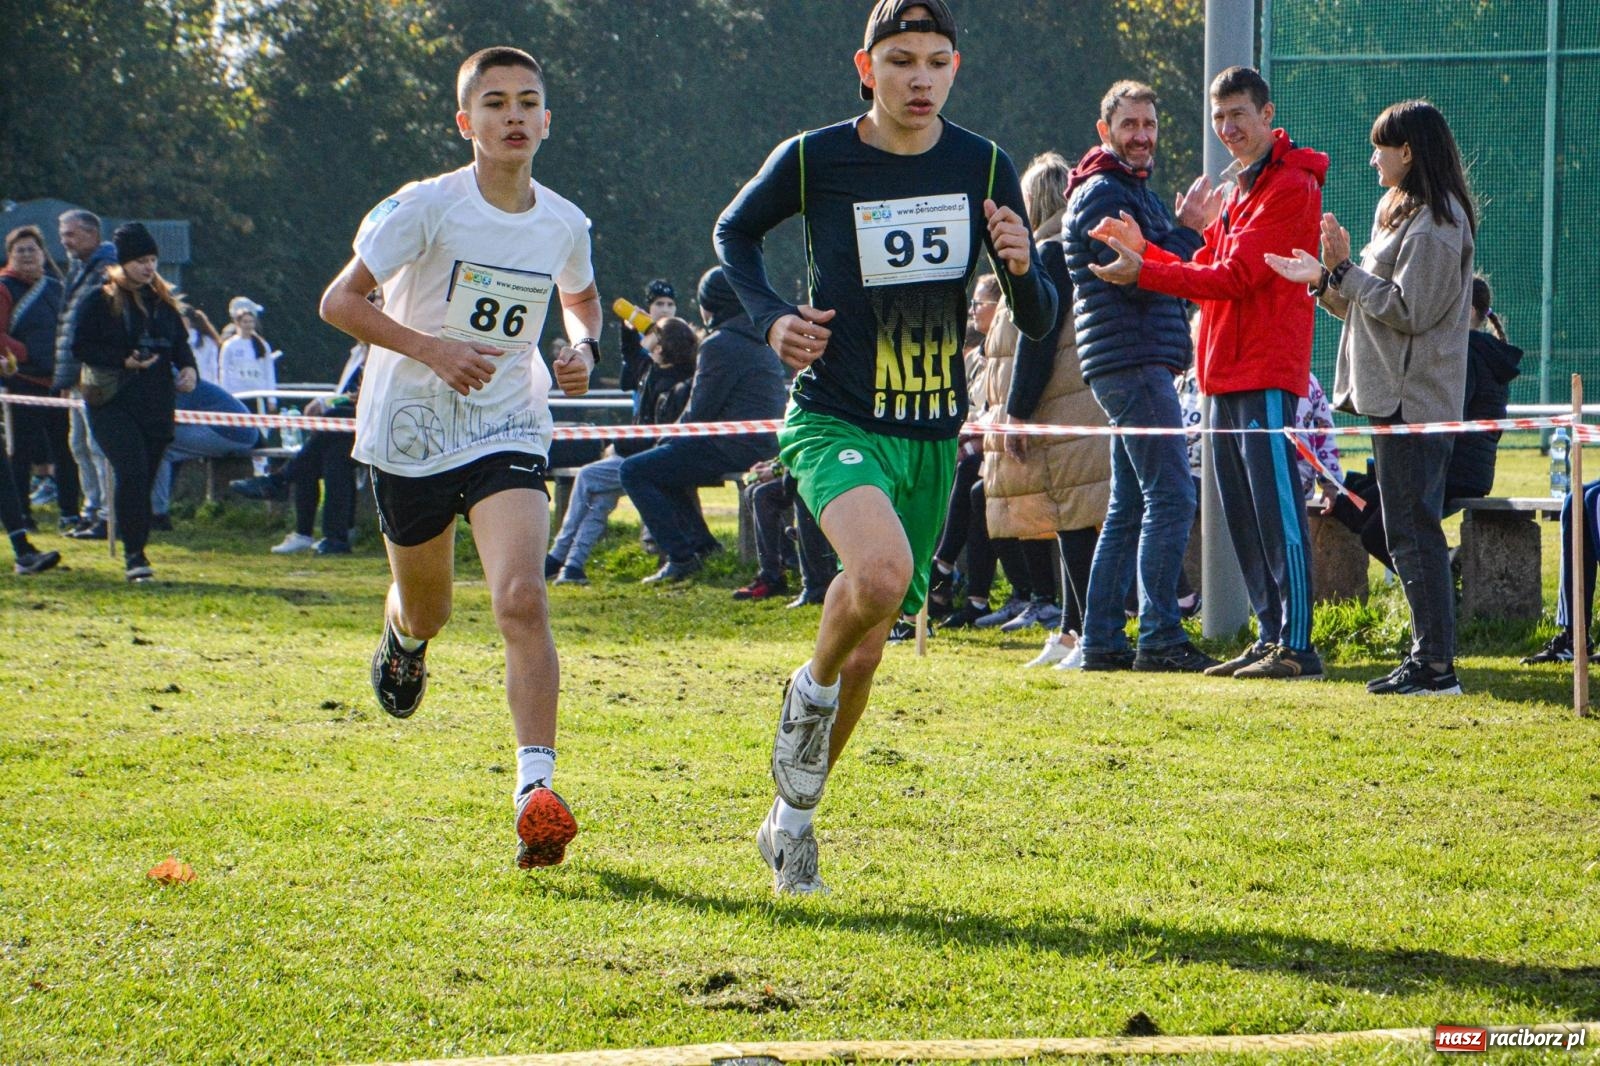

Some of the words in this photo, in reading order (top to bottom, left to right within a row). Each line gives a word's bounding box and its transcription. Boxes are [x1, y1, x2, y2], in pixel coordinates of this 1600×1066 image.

[897, 203, 964, 215] www.personalbest.pl
[884, 226, 949, 268] 95
[496, 280, 549, 295] www.personalbest.pl
[470, 297, 527, 337] 86
[873, 296, 958, 391] KEEP
[873, 390, 958, 420] GOING
